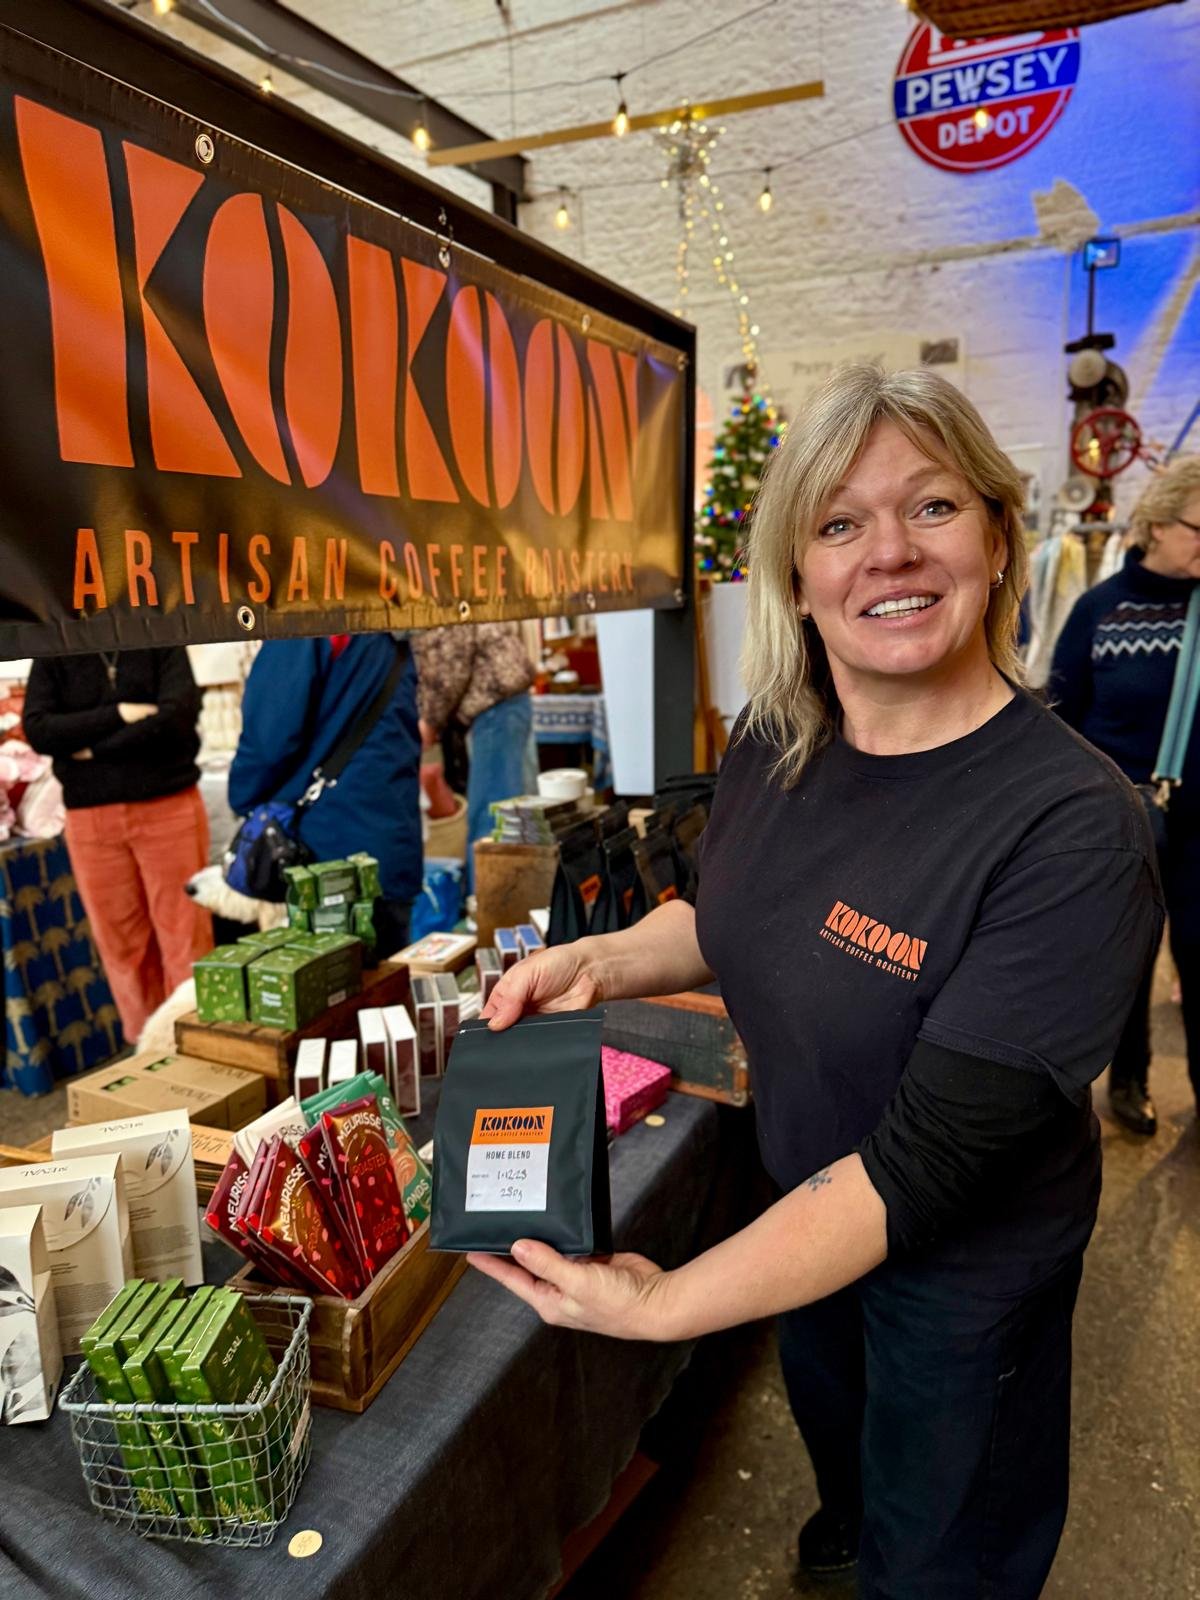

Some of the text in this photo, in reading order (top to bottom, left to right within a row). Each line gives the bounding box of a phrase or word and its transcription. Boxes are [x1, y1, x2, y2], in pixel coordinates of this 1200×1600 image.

[904, 46, 1068, 114] PEWSEY
[938, 105, 1034, 149] DEPOT
[15, 95, 639, 521] KOKOON
[73, 528, 635, 609] ARTISAN COFFEE ROASTERY
[819, 928, 918, 981] ARTISAN COFFEE ROASTERY
[825, 900, 928, 970] KOKOON
[336, 1111, 383, 1147] MEURISSE
[480, 1115, 545, 1131] KOKOON
[486, 1150, 531, 1160] HOME BLEND
